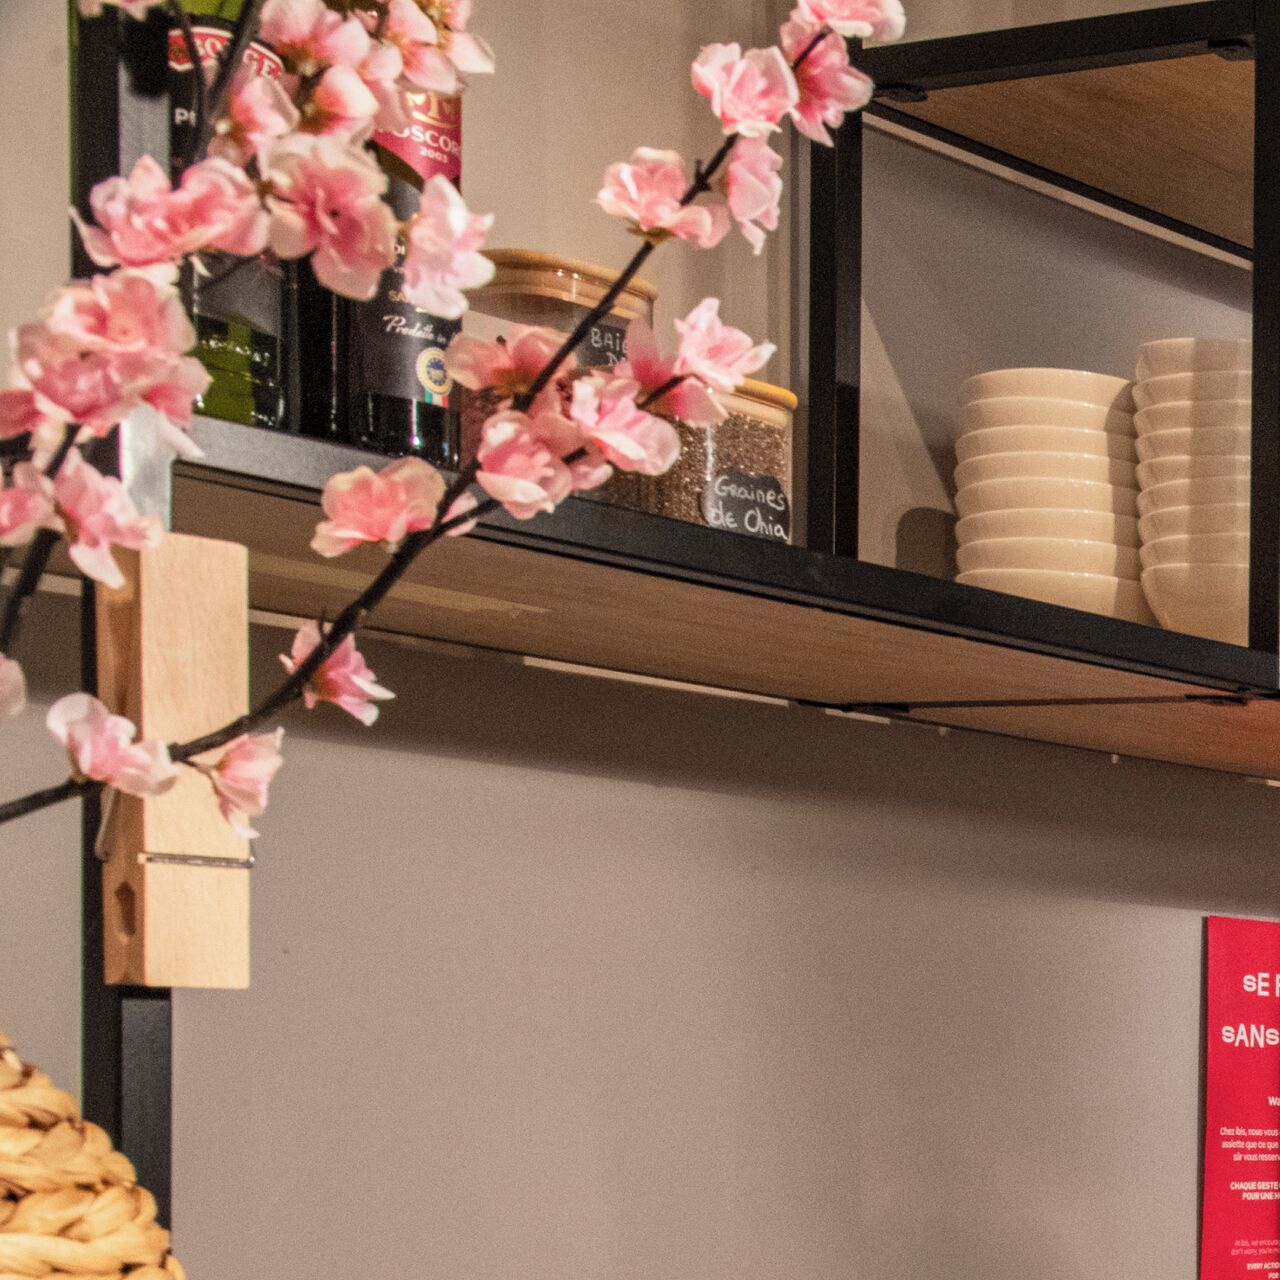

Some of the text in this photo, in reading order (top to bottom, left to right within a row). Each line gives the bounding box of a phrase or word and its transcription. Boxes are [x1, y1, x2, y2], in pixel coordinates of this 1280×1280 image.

[714, 476, 787, 511] Graines
[1243, 973, 1270, 996] SE
[1221, 1024, 1280, 1048] SANS
[1230, 1182, 1256, 1190] CHAQUE
[1257, 1182, 1278, 1190] GESTE
[1242, 1192, 1260, 1200] POUR
[1260, 1192, 1274, 1200] UNE
